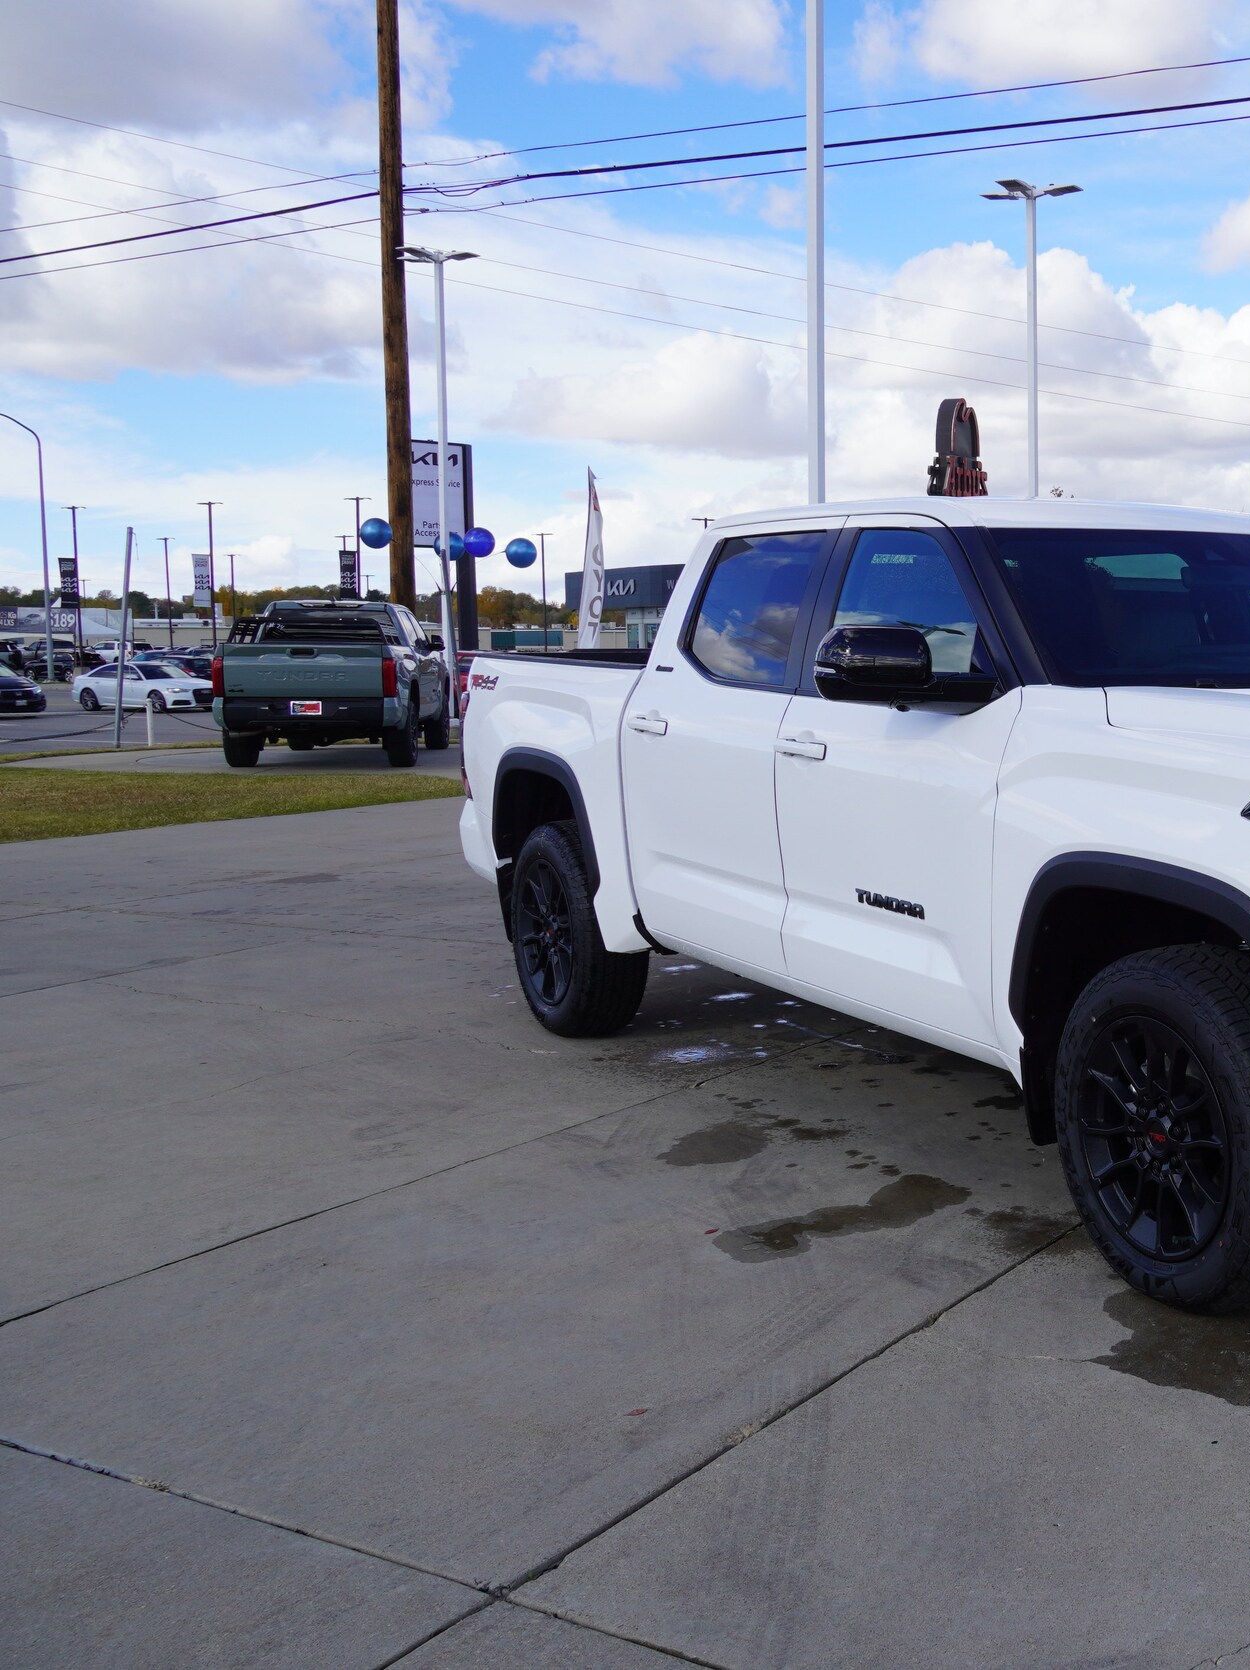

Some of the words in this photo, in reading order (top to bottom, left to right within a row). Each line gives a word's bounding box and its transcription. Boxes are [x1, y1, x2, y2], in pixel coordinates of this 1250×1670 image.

[422, 521, 440, 529] Part
[257, 670, 349, 682] TUNDRA
[855, 888, 925, 920] TUNDRA
